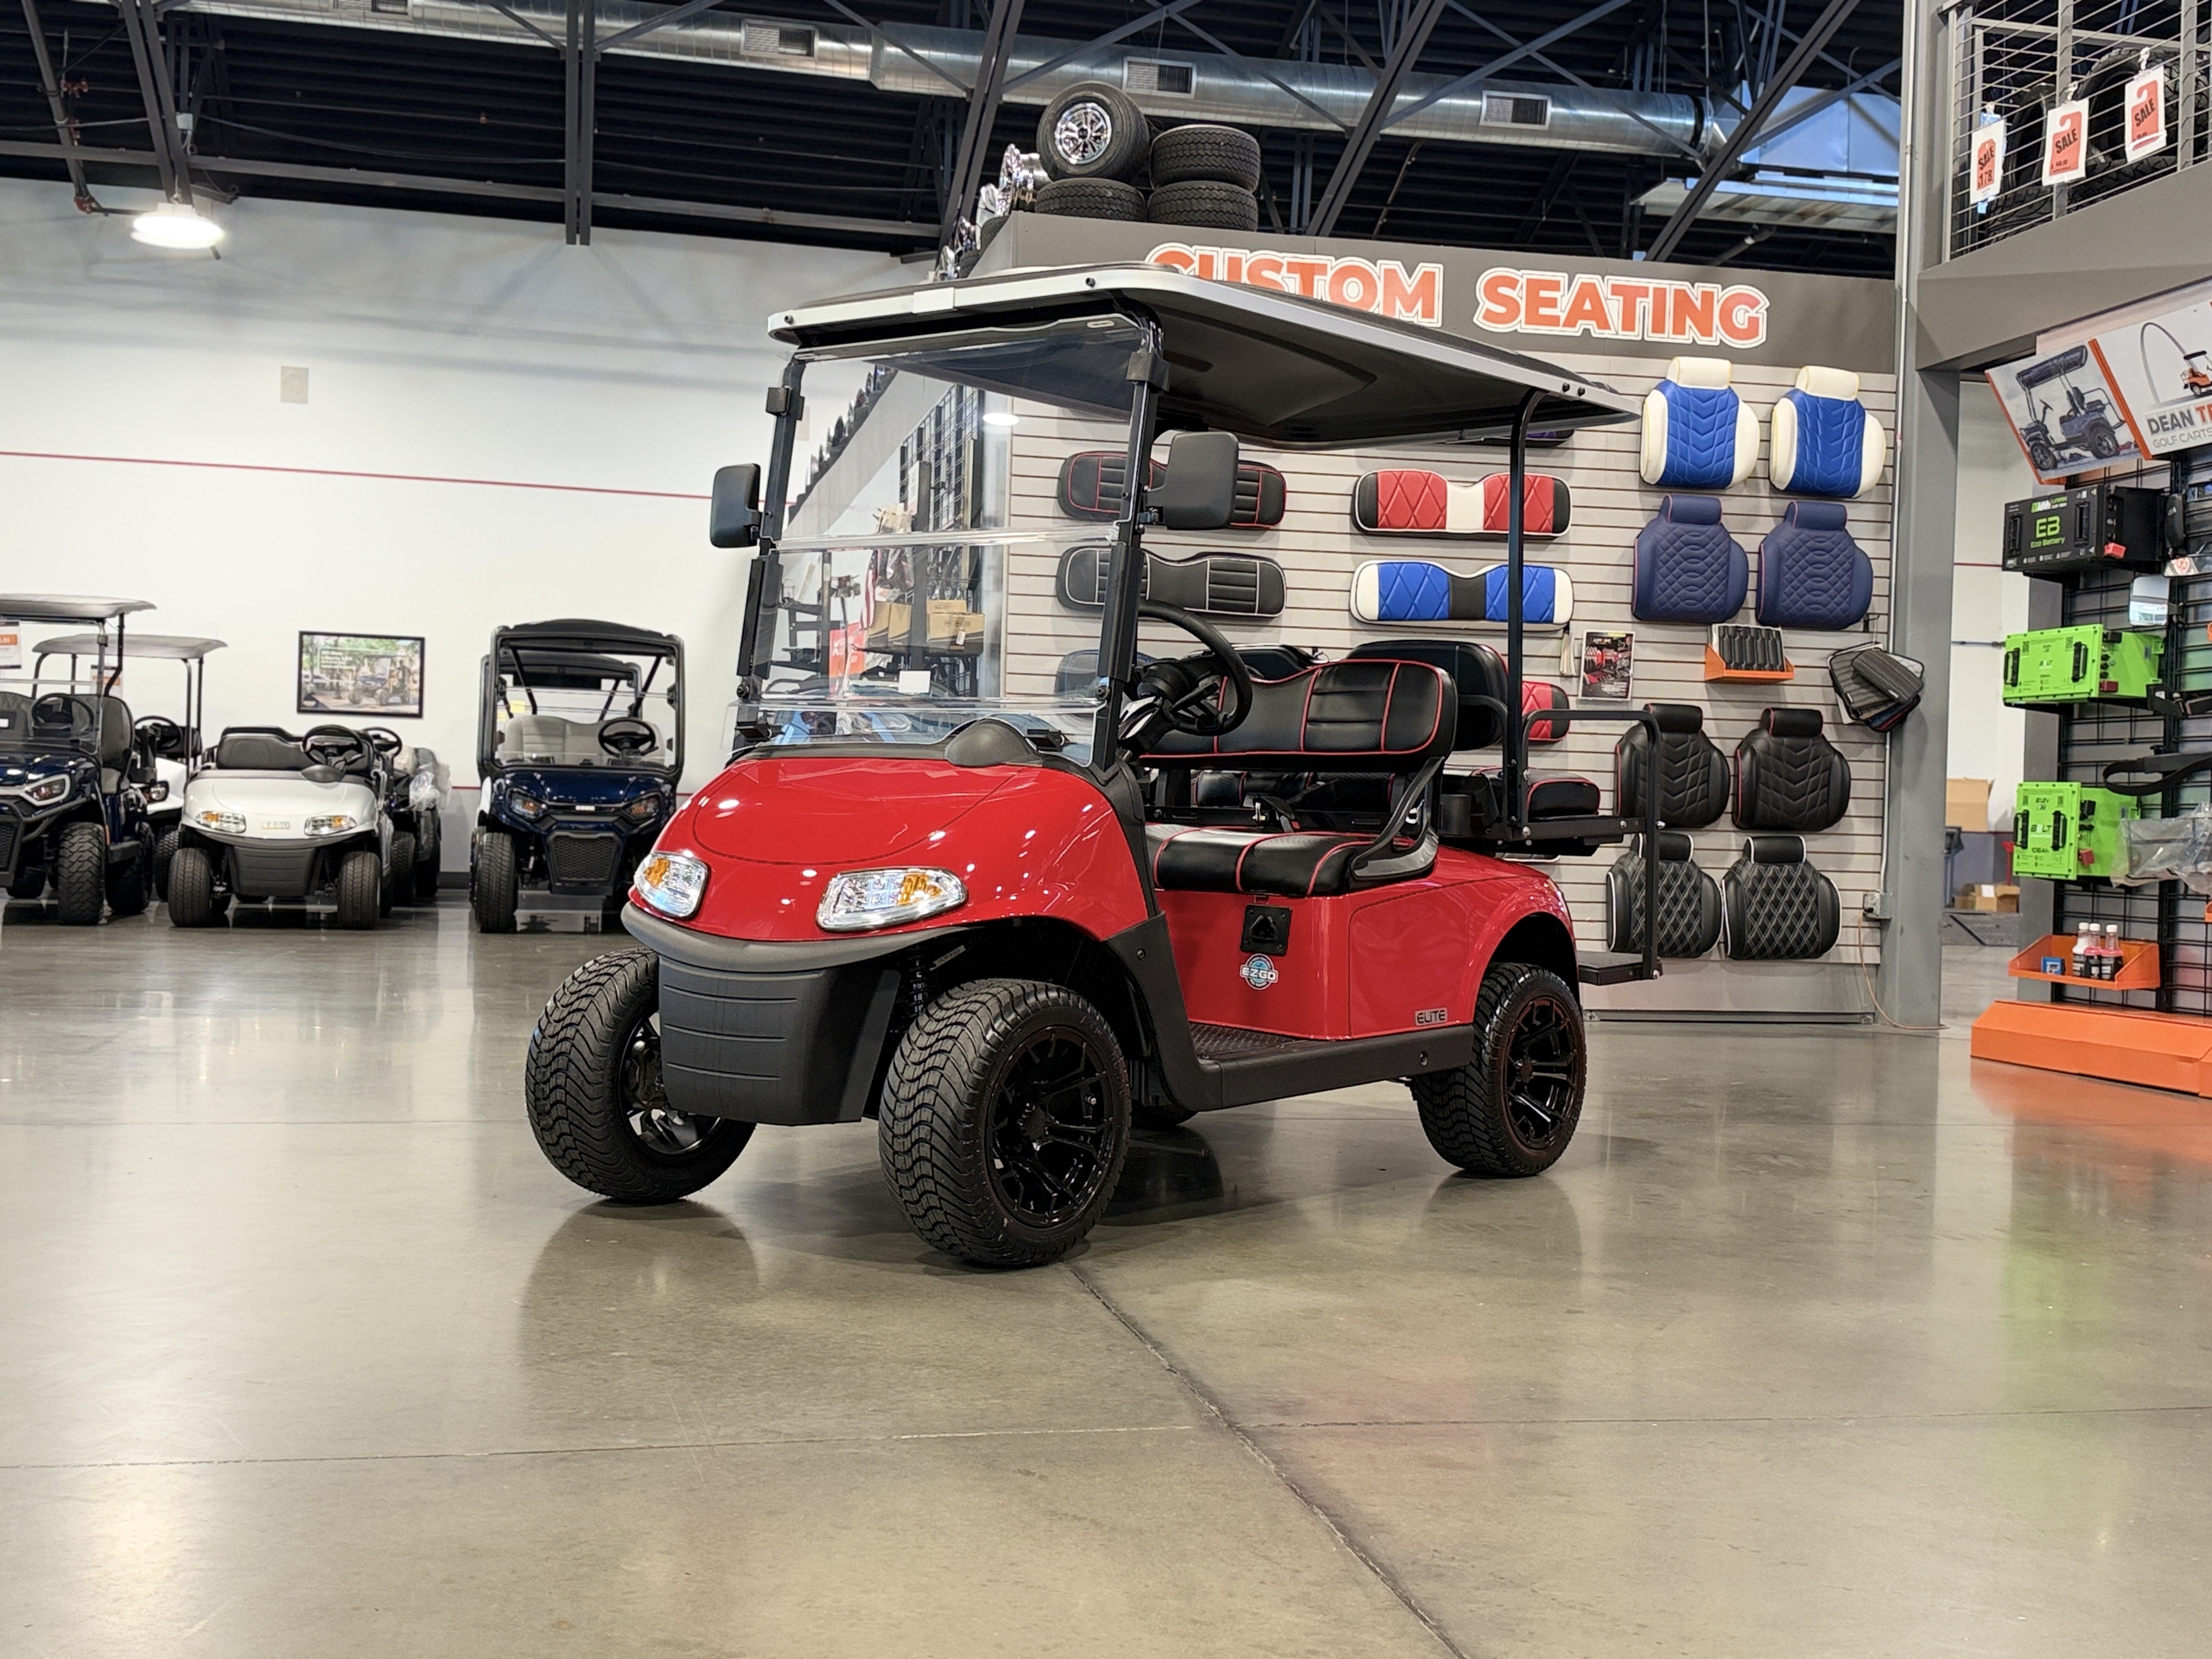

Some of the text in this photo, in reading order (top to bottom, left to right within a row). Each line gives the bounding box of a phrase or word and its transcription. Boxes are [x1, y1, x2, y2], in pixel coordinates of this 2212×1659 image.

[2134, 98, 2155, 127] SALE
[2055, 128, 2078, 154] SALE
[1978, 145, 1995, 170] SALE
[1475, 268, 1769, 347] SEATING
[2147, 409, 2194, 434] DEAN
[2153, 427, 2212, 448] GOLF CARTS
[2036, 516, 2060, 538] EB
[2042, 537, 2066, 546] Battery
[1242, 967, 1277, 980] EZGO
[1417, 1009, 1446, 1024] ELITE
